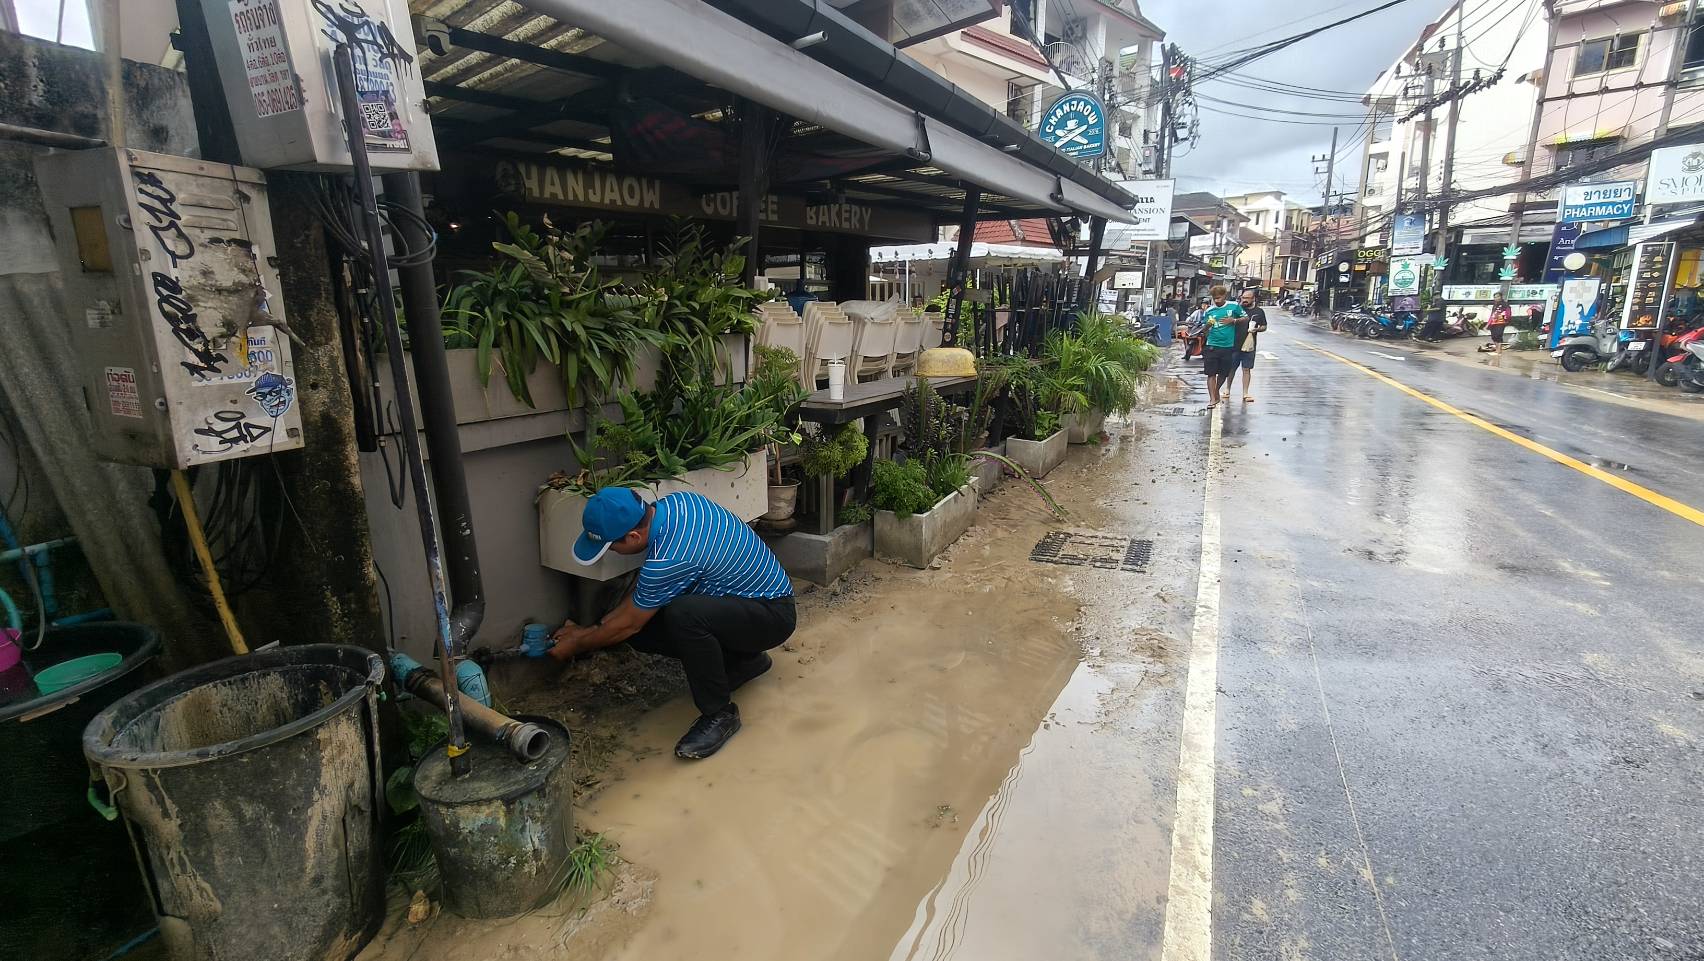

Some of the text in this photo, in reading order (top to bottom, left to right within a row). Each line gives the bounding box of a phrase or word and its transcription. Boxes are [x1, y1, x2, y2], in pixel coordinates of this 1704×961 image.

[1045, 100, 1099, 133] CHANJAOW
[505, 161, 661, 209] HANJAOW
[806, 203, 873, 232] BAKERY
[1583, 187, 1632, 201] ขายยา
[1133, 207, 1166, 215] ANSION
[1564, 203, 1631, 219] PHARMACY
